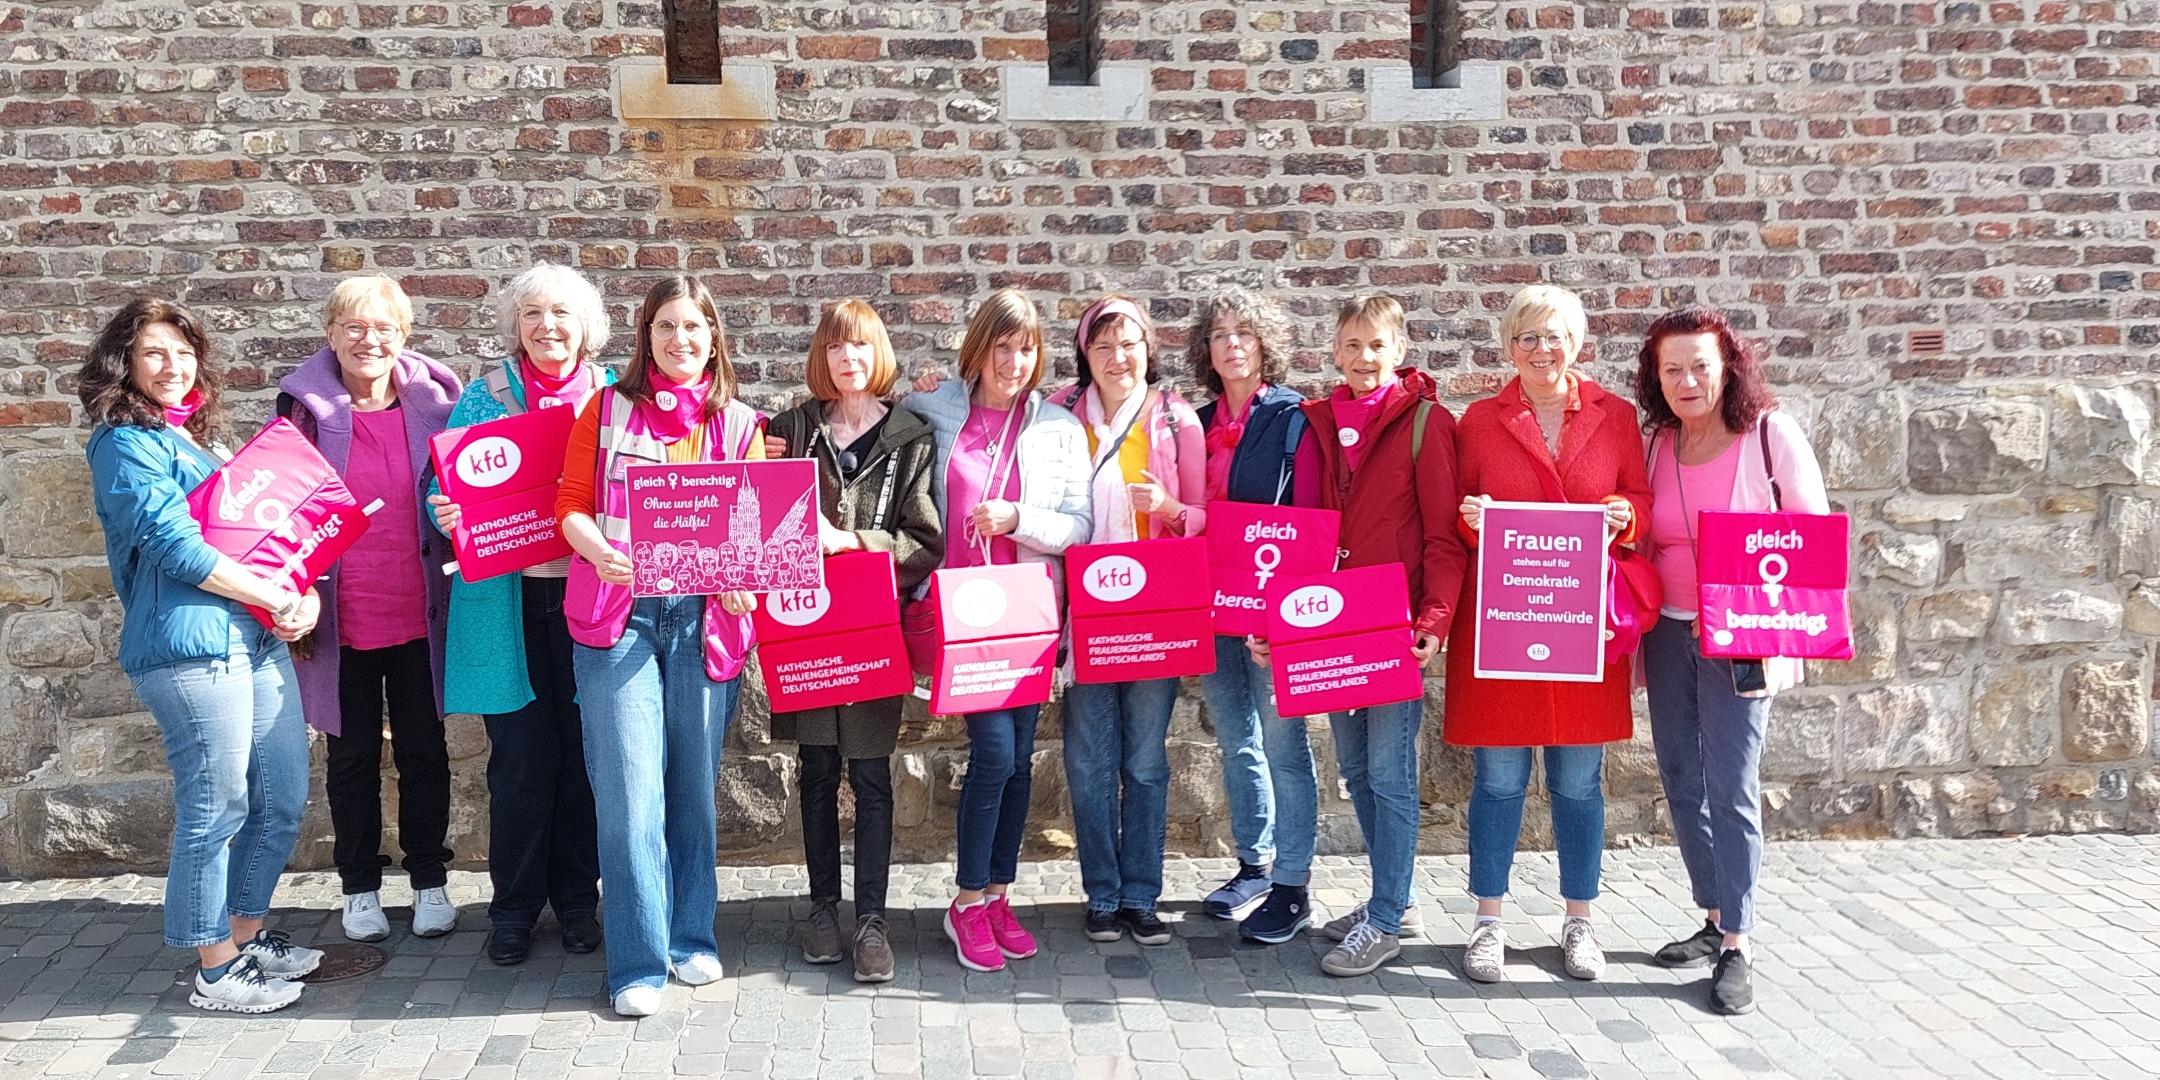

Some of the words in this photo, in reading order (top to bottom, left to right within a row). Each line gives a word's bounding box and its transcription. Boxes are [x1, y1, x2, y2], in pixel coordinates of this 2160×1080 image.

[659, 396, 672, 406] kfd
[470, 446, 508, 475] kfd
[633, 475, 666, 491] gleich
[681, 475, 737, 487] berechtigt
[218, 468, 278, 523] gleich
[643, 497, 672, 511] Ohne
[674, 499, 693, 508] uns
[695, 497, 720, 513] fehlt
[471, 509, 538, 534] KATHOLISCHE
[653, 516, 669, 529] die
[671, 515, 710, 532] Hälfte!
[1244, 520, 1297, 542] gleich
[1503, 529, 1582, 551] Frauen
[477, 530, 555, 558] DEUTSCHLANDS
[1745, 529, 1804, 554] gleich
[1512, 557, 1541, 567] stehen
[1543, 557, 1556, 567] auf
[1557, 558, 1571, 568] für
[1097, 566, 1132, 588] kfd
[1503, 573, 1580, 588] Demokratie
[780, 590, 817, 612] kfd
[1295, 595, 1329, 616] kfd
[1527, 592, 1553, 604] und
[1486, 608, 1594, 624] Menschenwürde
[1725, 608, 1829, 637] berechtigt
[1088, 633, 1153, 645] KATHOLISCHE
[1088, 639, 1199, 655] FRAUENGEMEINSCHAFT
[1089, 652, 1166, 666] DEUTSCHLANDS
[1531, 647, 1546, 656] kfd
[776, 655, 844, 673] KATHOLISCHE
[779, 658, 891, 684] FRAUENGEMEINSCHAFT
[953, 659, 1011, 674] KATHOLISCHE
[1287, 655, 1354, 672] KATHOLISCHE
[1288, 659, 1401, 684] FRAUENGEMEINSCHAFT
[782, 675, 860, 695] DEUTSCHLANDS
[949, 680, 1017, 696] DEUTSCHLANDS
[1290, 676, 1368, 695] DEUTSCHLANDS
